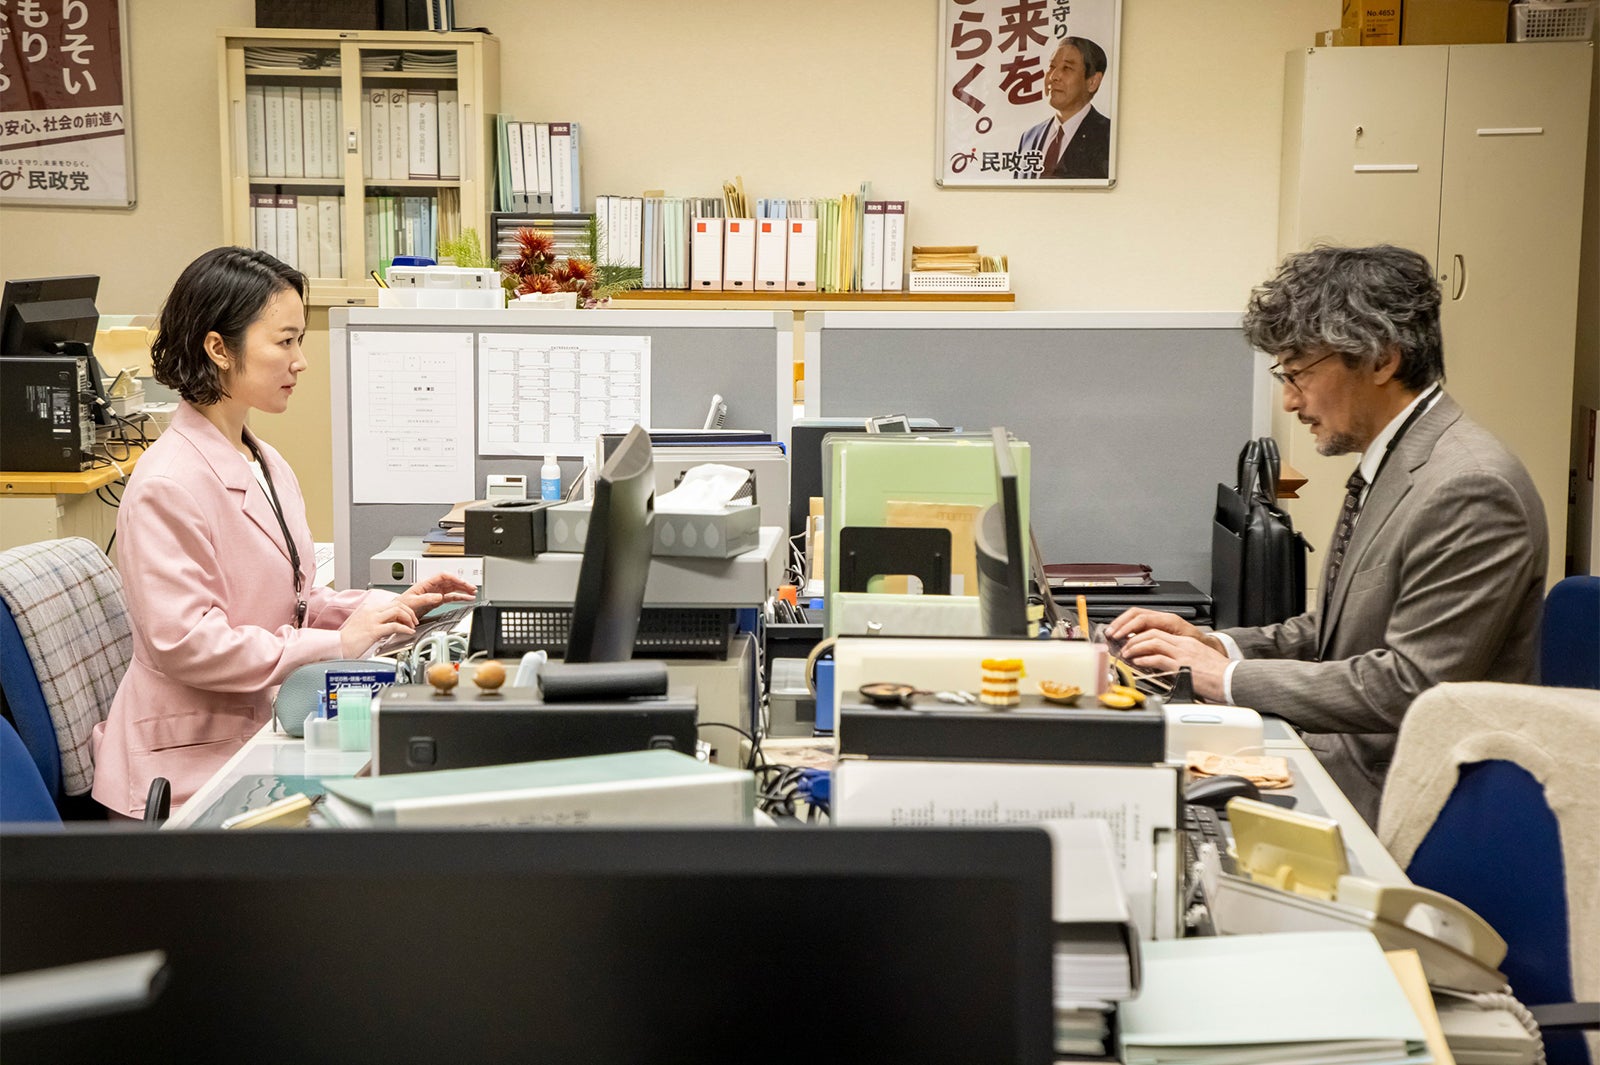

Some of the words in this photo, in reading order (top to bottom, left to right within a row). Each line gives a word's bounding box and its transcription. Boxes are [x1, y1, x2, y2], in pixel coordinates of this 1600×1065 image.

[60, 0, 97, 95] りそい
[950, 0, 992, 134] らく。
[997, 0, 1050, 105] 来を
[0, 112, 123, 136] 安心、社会の前進へ
[28, 171, 90, 191] 民政党
[980, 152, 1043, 172] 民政党
